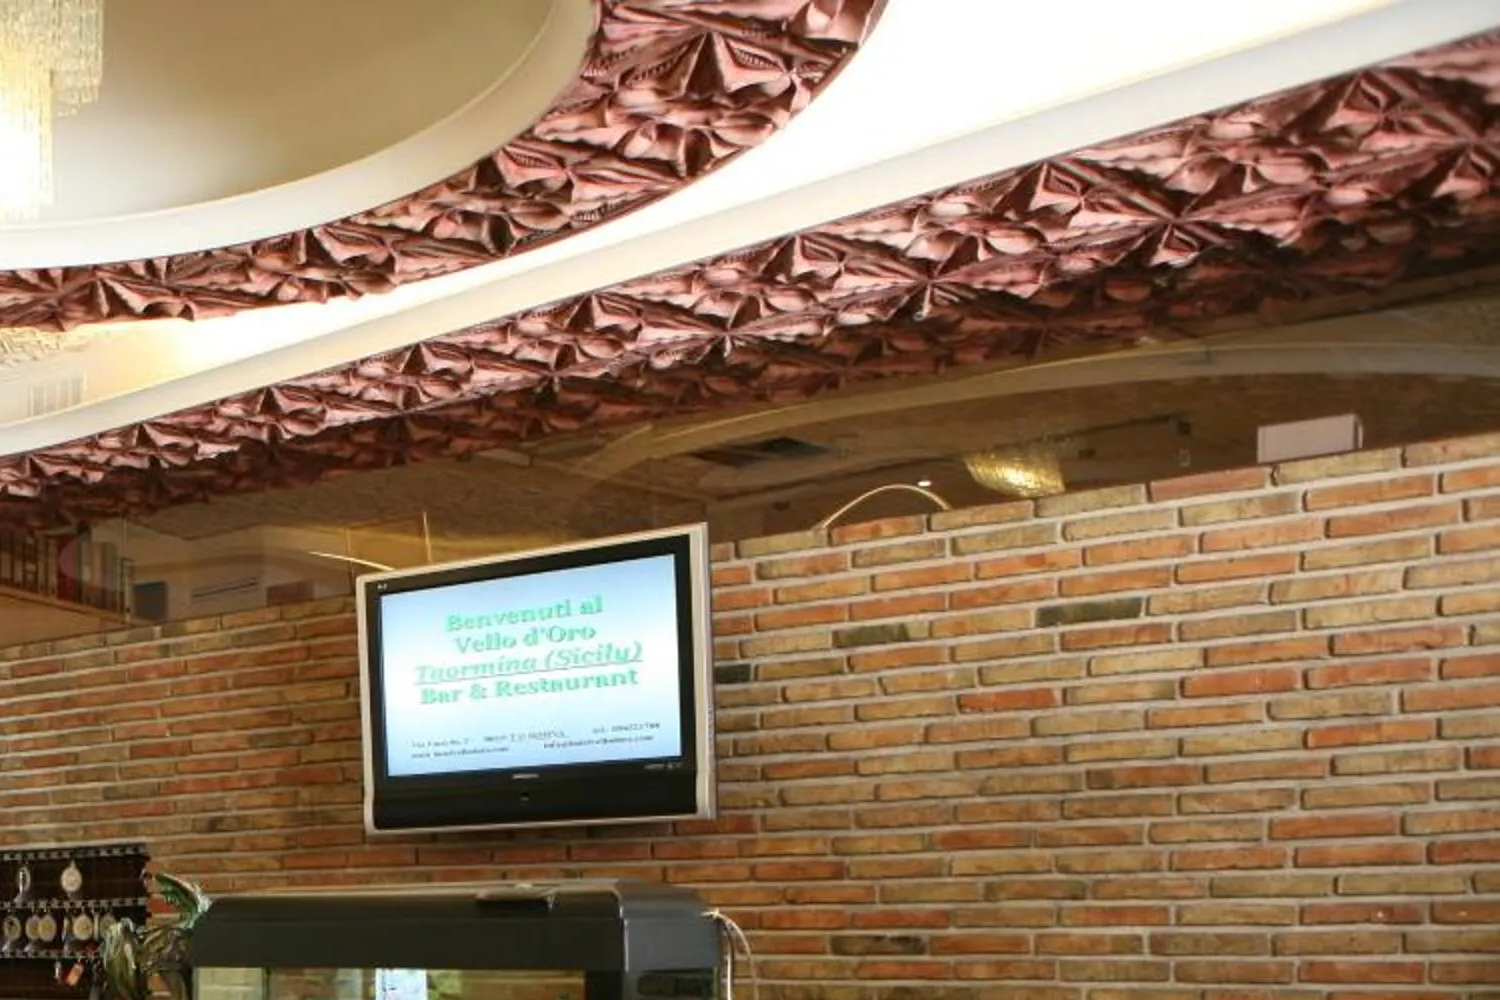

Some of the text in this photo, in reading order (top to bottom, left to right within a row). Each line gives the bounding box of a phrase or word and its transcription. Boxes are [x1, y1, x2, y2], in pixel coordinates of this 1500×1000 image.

[446, 595, 604, 631] Benvenuti al
[454, 625, 597, 654] Vello d'Oro
[416, 641, 644, 682] Taormina (Sicily)
[420, 668, 639, 705] Bar & Restaurant
